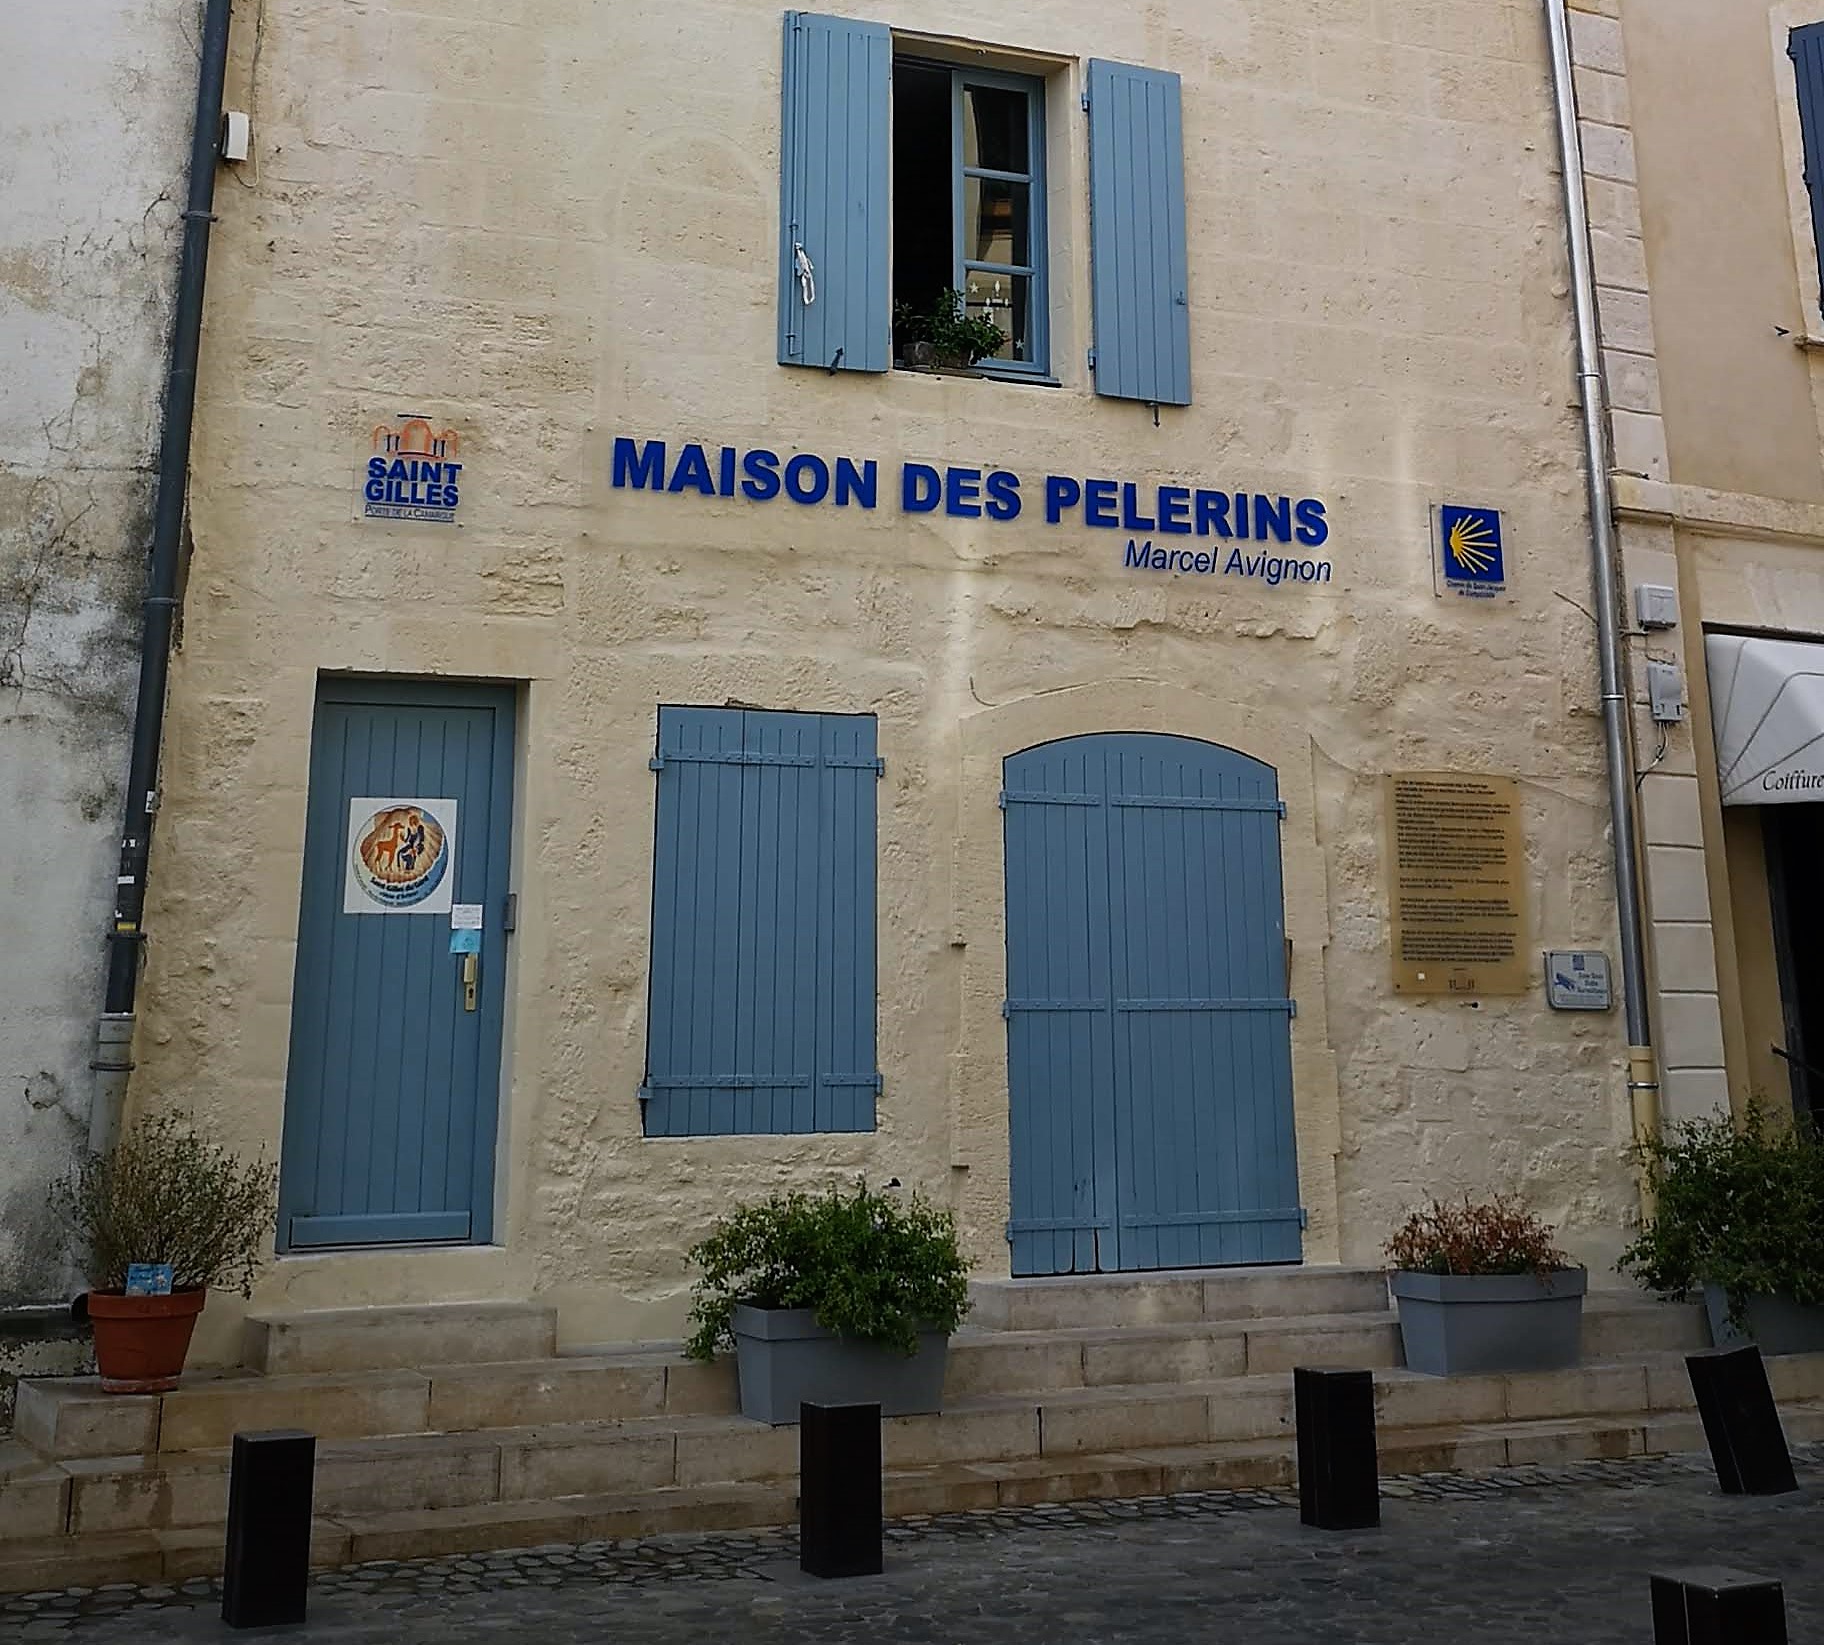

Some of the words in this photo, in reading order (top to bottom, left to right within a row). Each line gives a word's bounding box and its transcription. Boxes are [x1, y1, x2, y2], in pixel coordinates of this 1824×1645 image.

[368, 457, 462, 484] SAINT
[365, 479, 459, 507] GILLES
[611, 438, 878, 508] MAISON
[901, 463, 1022, 521] DES
[1045, 476, 1329, 546] PELERINS
[1125, 539, 1218, 573] Marcel
[1224, 548, 1332, 585] Avignon
